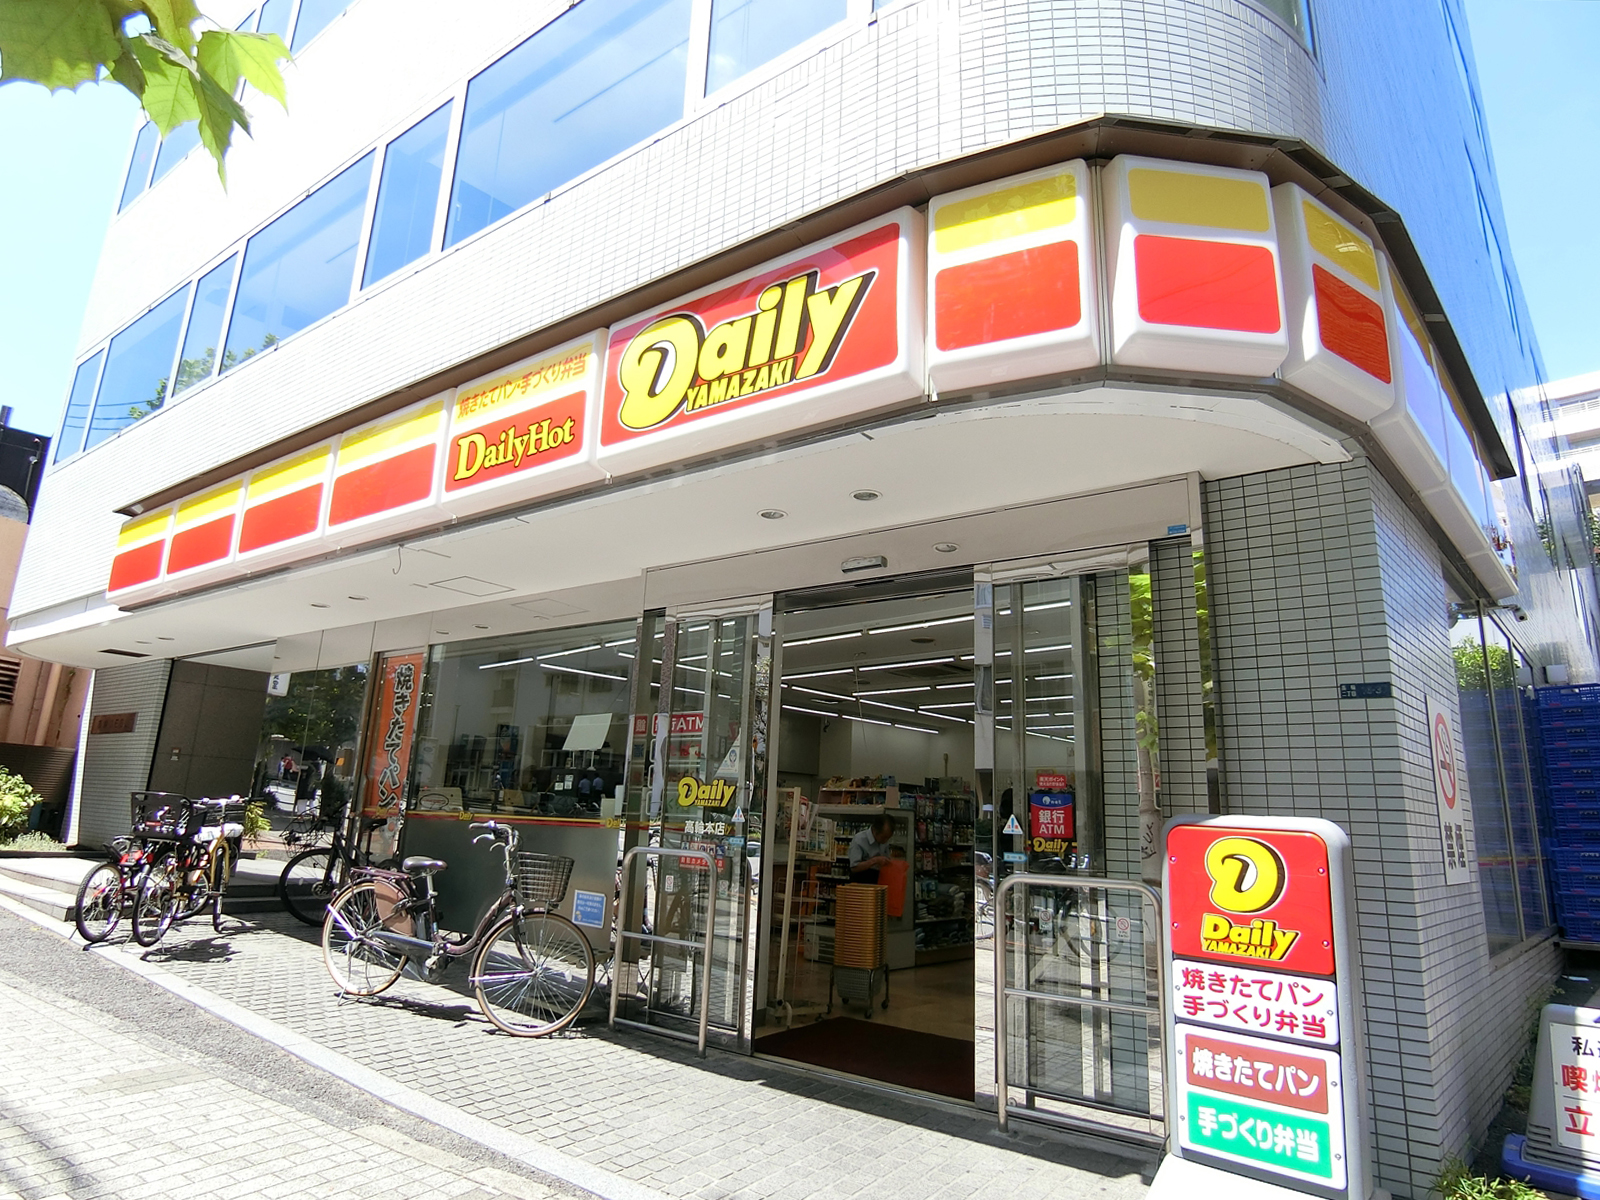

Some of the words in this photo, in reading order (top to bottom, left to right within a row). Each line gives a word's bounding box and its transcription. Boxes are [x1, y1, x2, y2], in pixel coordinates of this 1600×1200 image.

[619, 269, 879, 432] Daily
[685, 356, 796, 413] YAMAZAKI
[378, 663, 415, 809] 焼きたてパン
[677, 776, 738, 807] Daily
[1038, 810, 1065, 824] 銀行
[1039, 824, 1065, 835] ATM
[1033, 837, 1068, 852] Daily
[1443, 821, 1467, 870] 禁煙
[1200, 912, 1300, 962] Daily
[1201, 937, 1272, 960] YAMAZAKI
[1181, 966, 1324, 1008] 焼きたてパン
[1182, 994, 1326, 1039] 手づくり弁当
[1192, 1046, 1320, 1096] 焼きたてパン
[1197, 1105, 1320, 1163] 手づくり弁当
